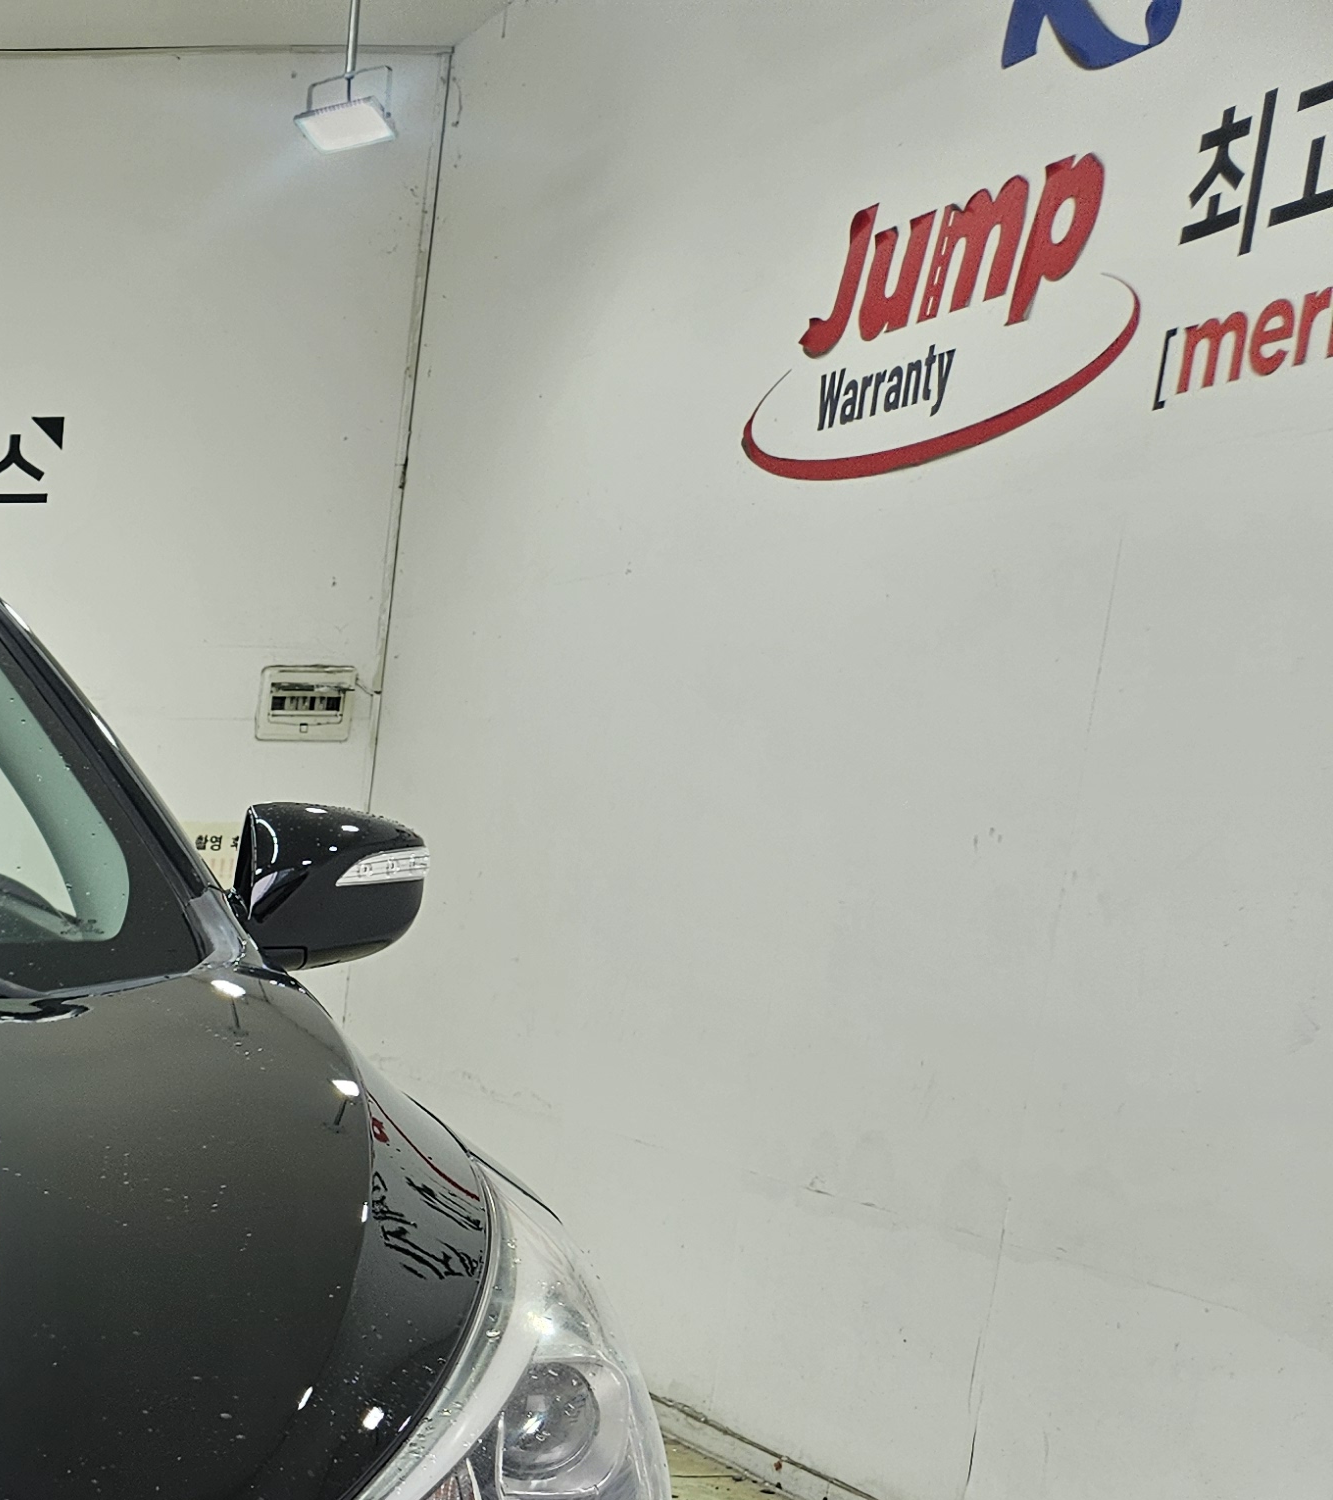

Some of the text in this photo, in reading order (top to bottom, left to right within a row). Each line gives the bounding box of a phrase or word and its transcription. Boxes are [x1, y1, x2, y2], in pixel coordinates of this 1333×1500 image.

[799, 152, 1105, 360] Jump
[817, 344, 957, 432] Warranty
[1152, 286, 1333, 411] [mer
